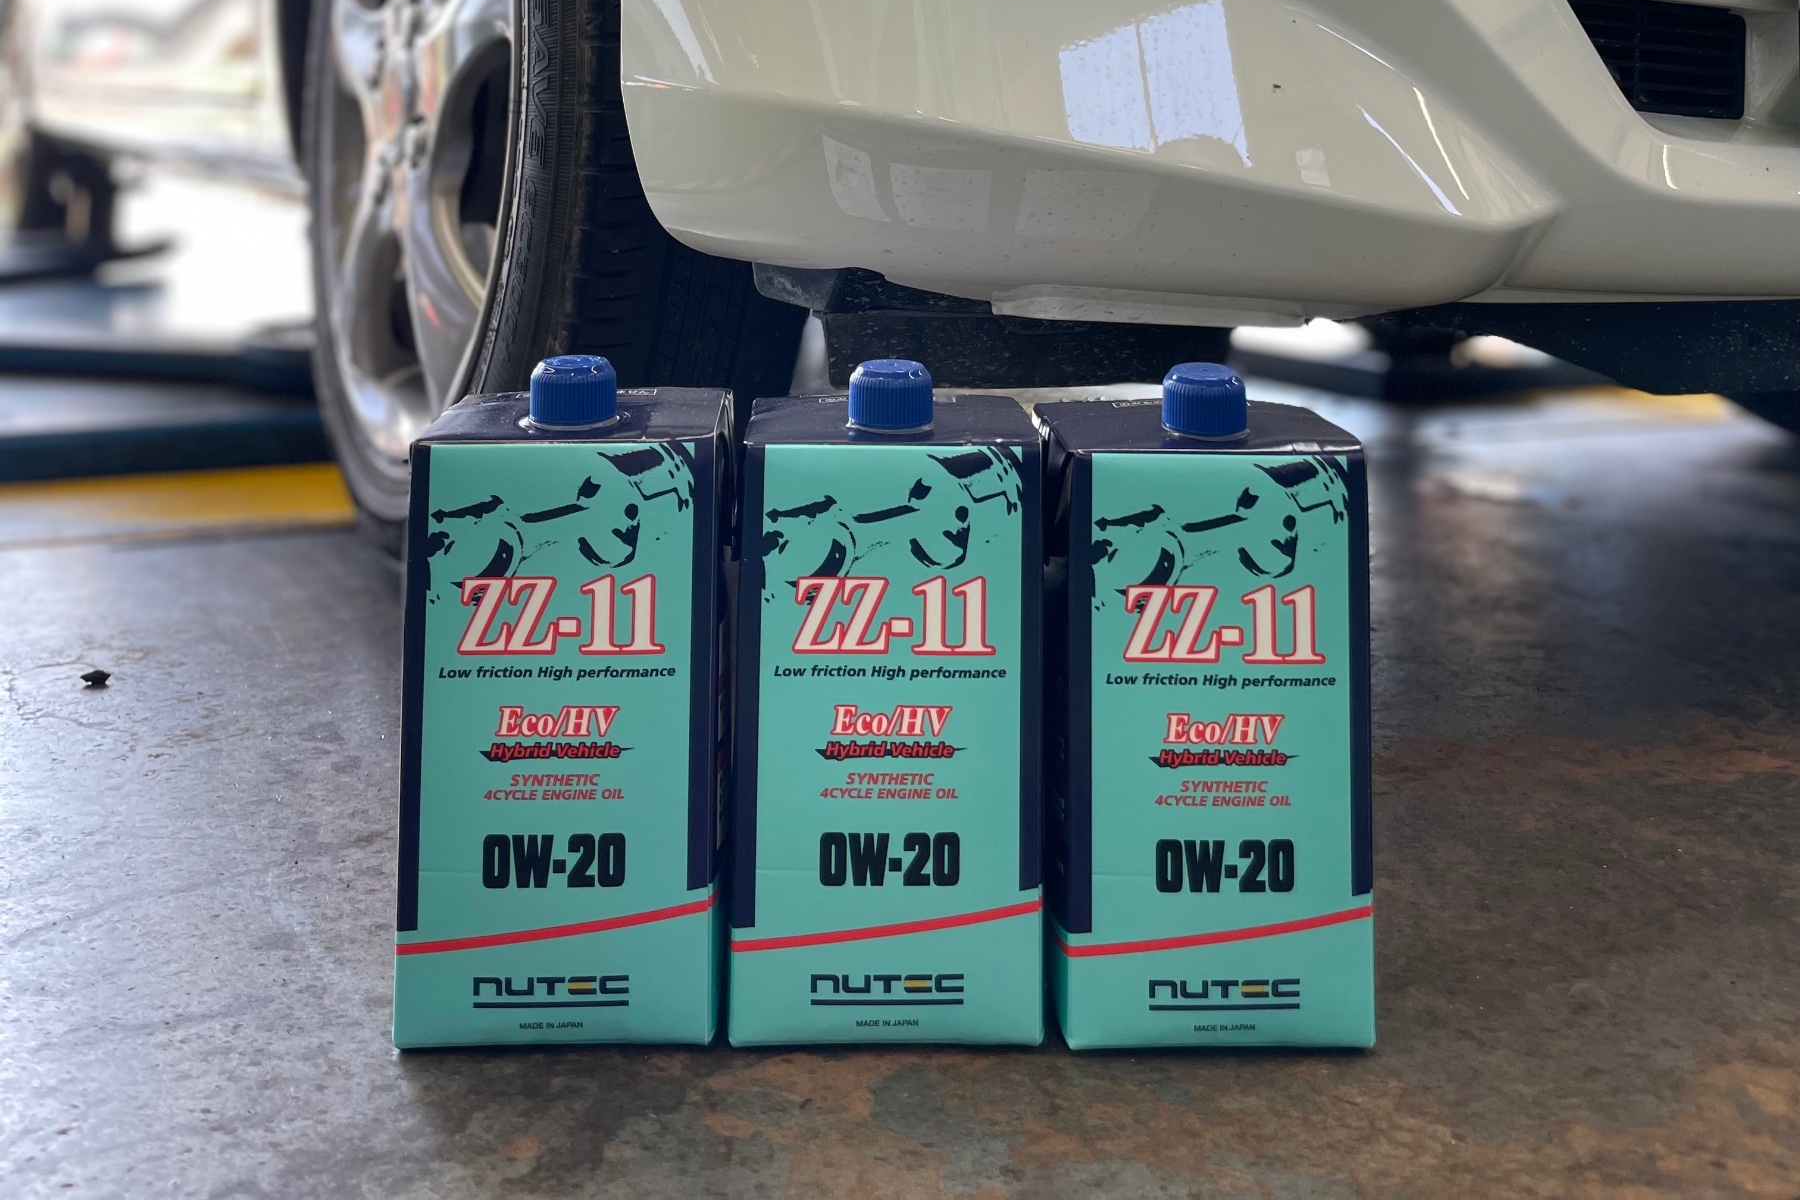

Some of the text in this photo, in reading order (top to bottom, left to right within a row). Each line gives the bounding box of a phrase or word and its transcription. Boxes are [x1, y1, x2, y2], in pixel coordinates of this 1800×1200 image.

[457, 573, 665, 655] ZZ-11
[792, 575, 996, 655] ZZ-11
[1123, 584, 1326, 664] ZZ-11
[439, 665, 676, 681] Low friction High performance
[774, 665, 1007, 681] Low friction High performance
[1106, 673, 1336, 690] Low friction High performance
[495, 705, 620, 737] Eco/HV
[830, 704, 952, 737] Eco/HV
[1164, 713, 1285, 745] Eco/HV
[490, 741, 621, 762] Hybrid Vehicle
[825, 740, 955, 761] Hybrid Vehicle
[1159, 749, 1288, 769] Hybrid Vehicle
[510, 773, 600, 787] SYNTHETIC
[846, 773, 934, 785] SYNTHETIC
[1180, 780, 1268, 793] SYNTHETIC
[483, 788, 624, 800] 4CYCLE ENGINE OIL
[820, 788, 958, 799] 4CYCLE ENGINE OIL
[1155, 795, 1291, 807] 4CYCLE ENGINE OIL
[482, 832, 626, 889] 0W-20
[820, 831, 960, 886] 0W-20
[1155, 838, 1295, 893] 0W-20
[519, 1022, 544, 1030] MADE
[556, 1021, 583, 1029] JAPAN
[856, 1019, 919, 1027] MADE IN JAPAN
[1193, 1024, 1218, 1032] MADE
[1229, 1023, 1256, 1031] JAPAN
